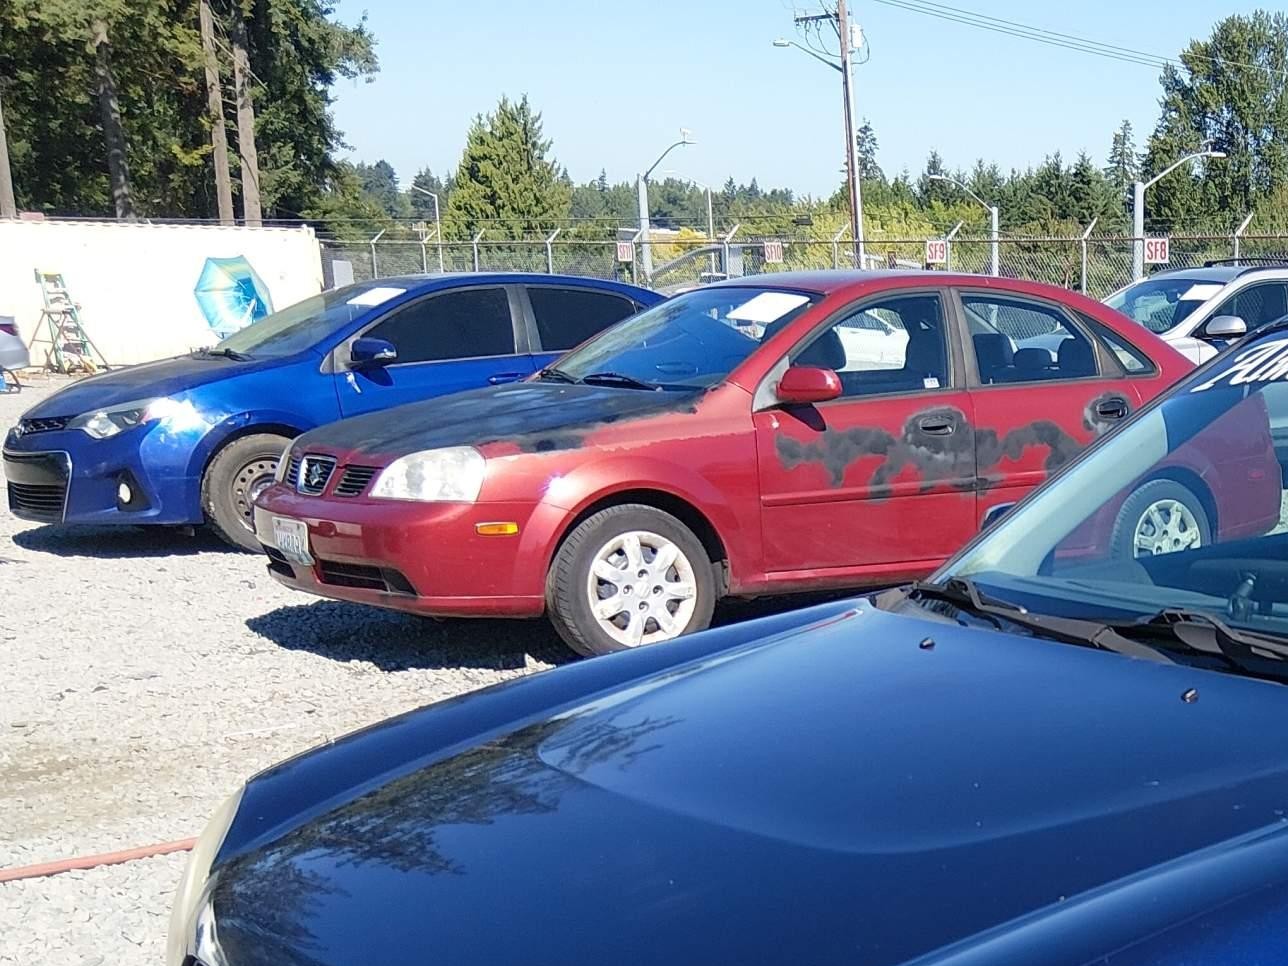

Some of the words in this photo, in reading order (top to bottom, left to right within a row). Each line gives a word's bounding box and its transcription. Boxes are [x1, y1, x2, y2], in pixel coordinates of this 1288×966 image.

[765, 244, 782, 260] SF10
[928, 243, 945, 260] SF9
[1147, 241, 1167, 260] SF8
